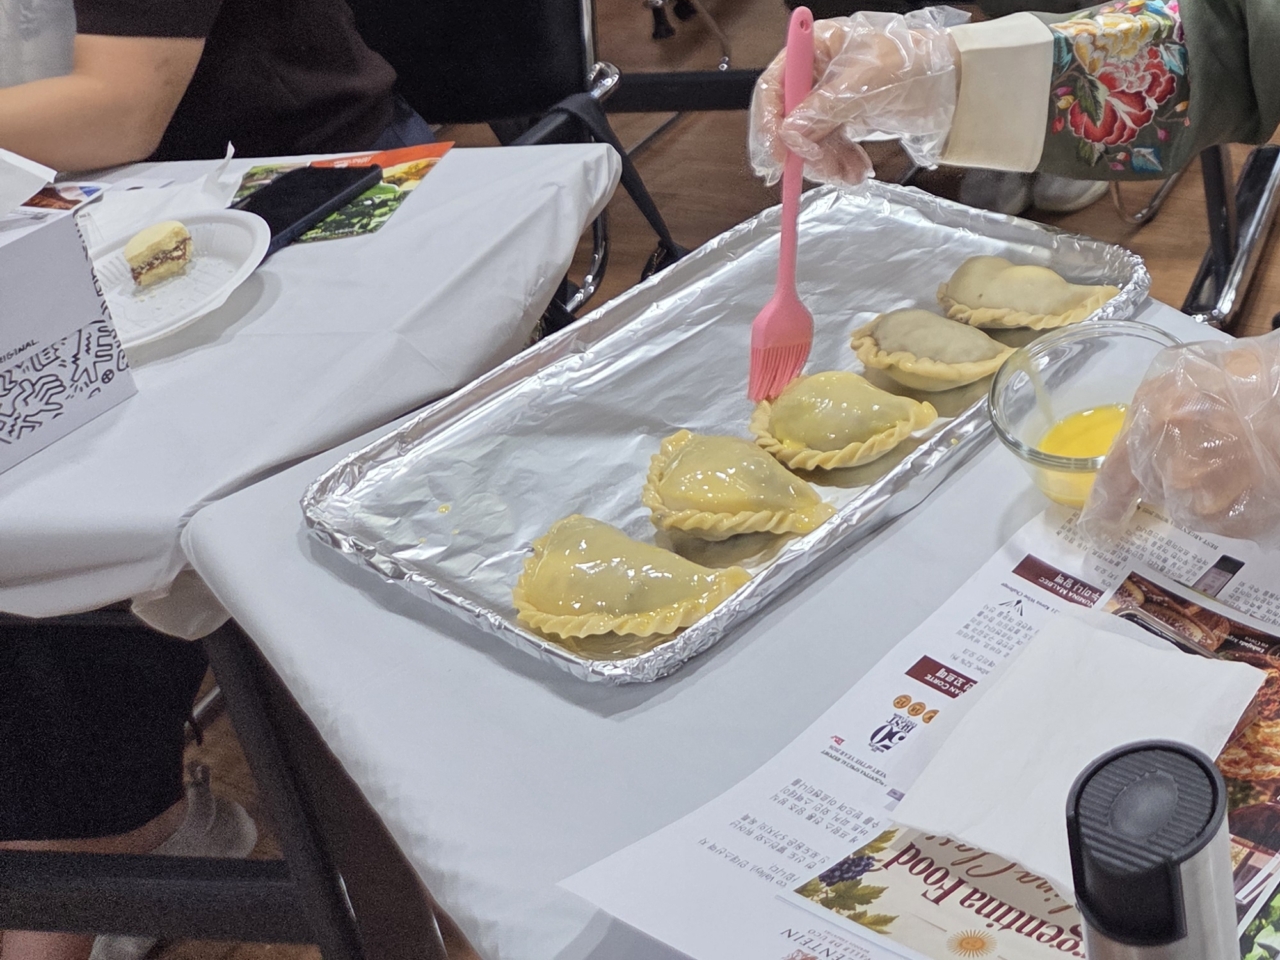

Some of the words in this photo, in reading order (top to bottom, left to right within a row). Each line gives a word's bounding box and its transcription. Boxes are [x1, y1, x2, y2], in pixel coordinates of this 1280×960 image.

[1166, 519, 1207, 541] ARGENTA
[1200, 538, 1220, 550] BEST
[1036, 576, 1069, 595] MALBEC
[1053, 572, 1076, 587] 말벡
[1000, 582, 1023, 595] Challenge
[1071, 582, 1103, 601] 누미나
[1021, 593, 1037, 602] Wine
[1034, 600, 1051, 610] Korea
[1066, 590, 1096, 607] NUMINA
[1238, 638, 1265, 653] Embajada
[974, 654, 998, 668] 메리칸
[922, 673, 951, 689] CORTE
[886, 716, 915, 733] BEST
[870, 724, 907, 750] 50
[860, 770, 887, 787] GENTINA
[768, 792, 790, 806] 방식
[788, 777, 840, 806] 아르헨티나를
[810, 802, 833, 816] 와인
[755, 821, 789, 841] 5가지의
[821, 821, 852, 839] 프랑스
[705, 842, 751, 868] 안데스산맥
[784, 837, 822, 859] 포도원은
[882, 842, 968, 906] Food
[808, 929, 828, 941] UCO
[780, 928, 850, 960] ENTEIN
